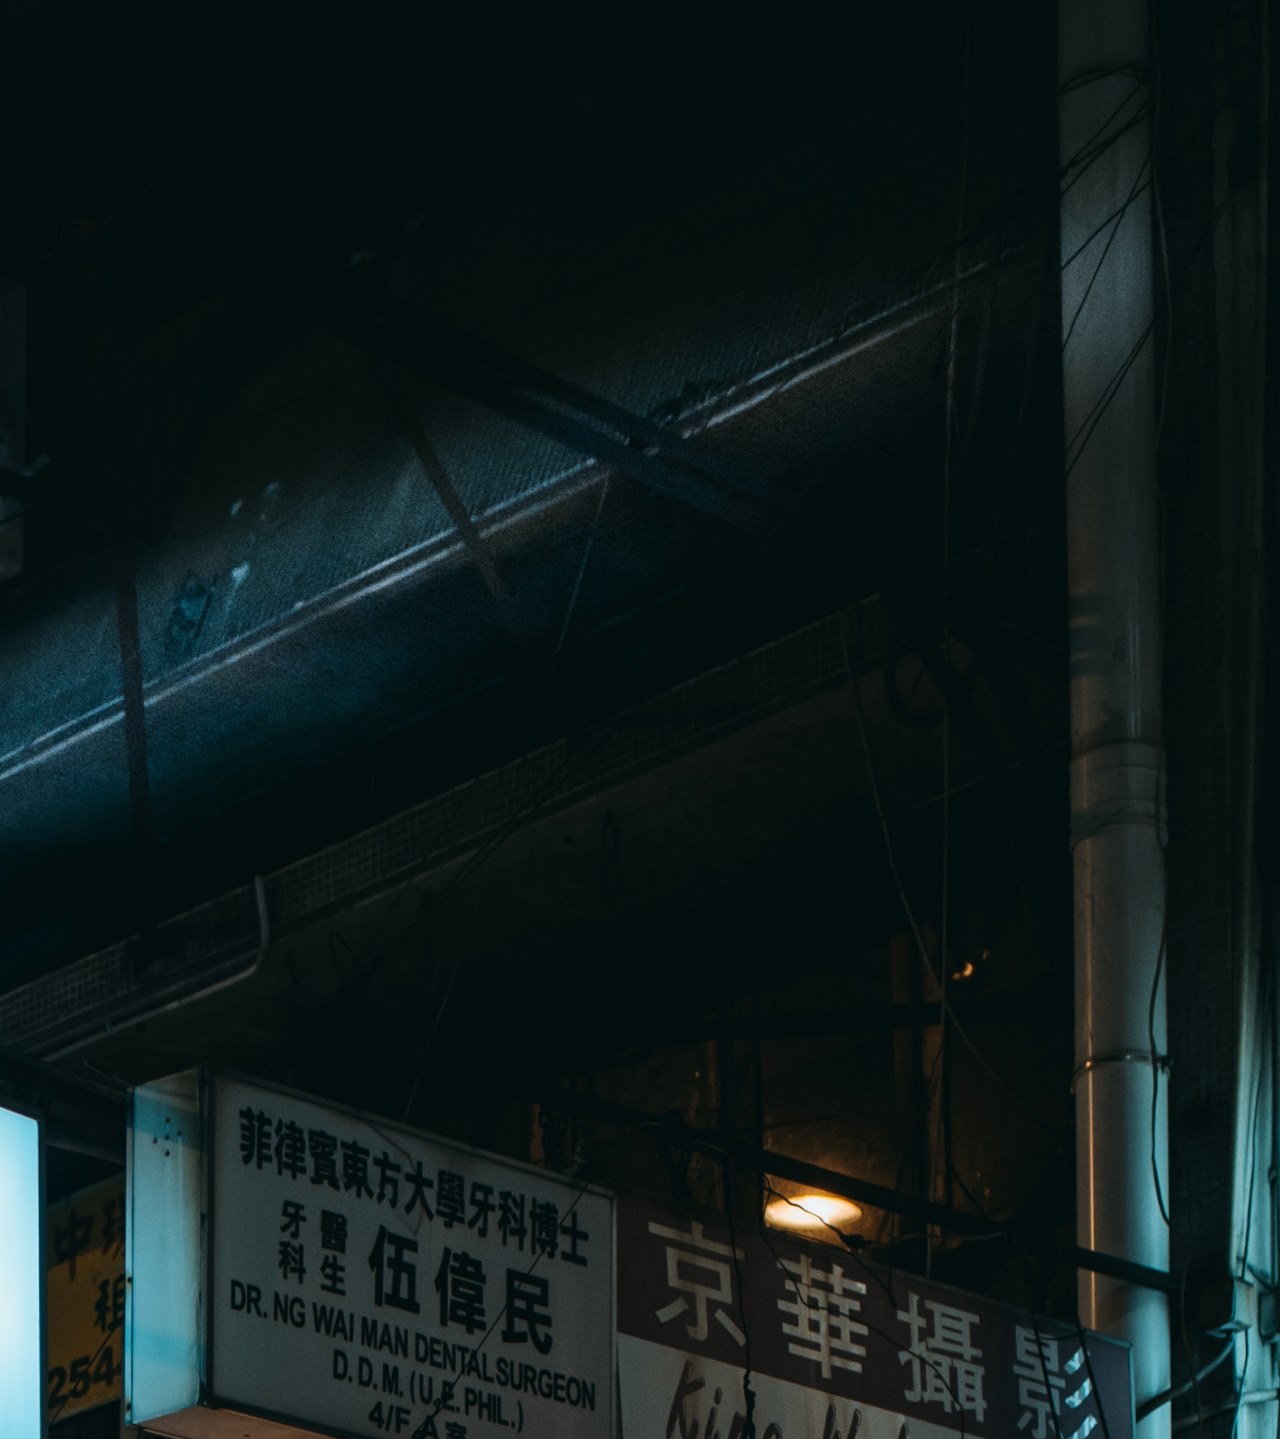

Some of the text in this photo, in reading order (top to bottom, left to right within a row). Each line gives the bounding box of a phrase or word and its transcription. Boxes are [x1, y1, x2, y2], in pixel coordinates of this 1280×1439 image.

[239, 1108, 590, 1266] 菲律賓東方大學牙科博士
[230, 1279, 596, 1411] DR. NG WAI MAN DENTAL SURGEON
[368, 1224, 553, 1355] 伍偉民
[368, 1401, 412, 1435] 4/F
